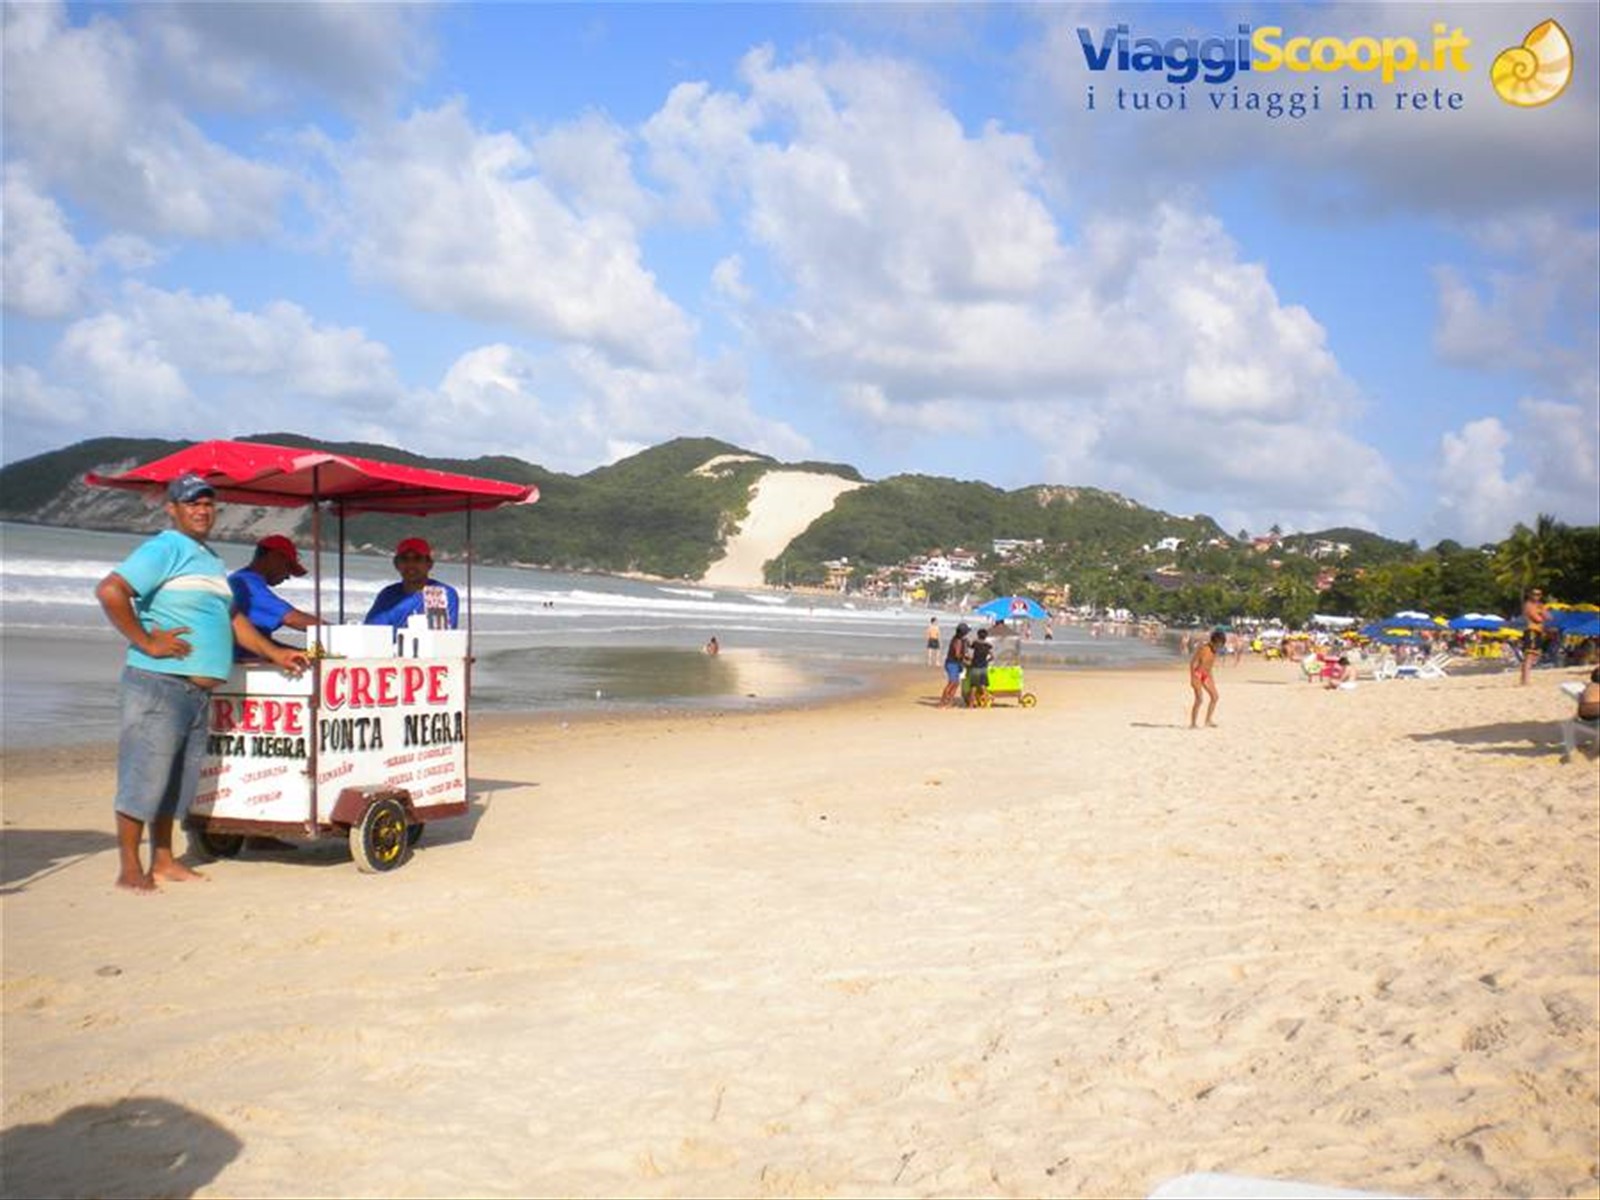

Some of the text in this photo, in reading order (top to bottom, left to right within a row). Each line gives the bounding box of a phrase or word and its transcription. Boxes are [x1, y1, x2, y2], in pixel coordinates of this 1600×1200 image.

[325, 665, 449, 710] CREPE
[212, 697, 303, 734] REPE
[319, 711, 464, 751] PONTA NEGRA
[207, 734, 306, 758] NTA NEGRA
